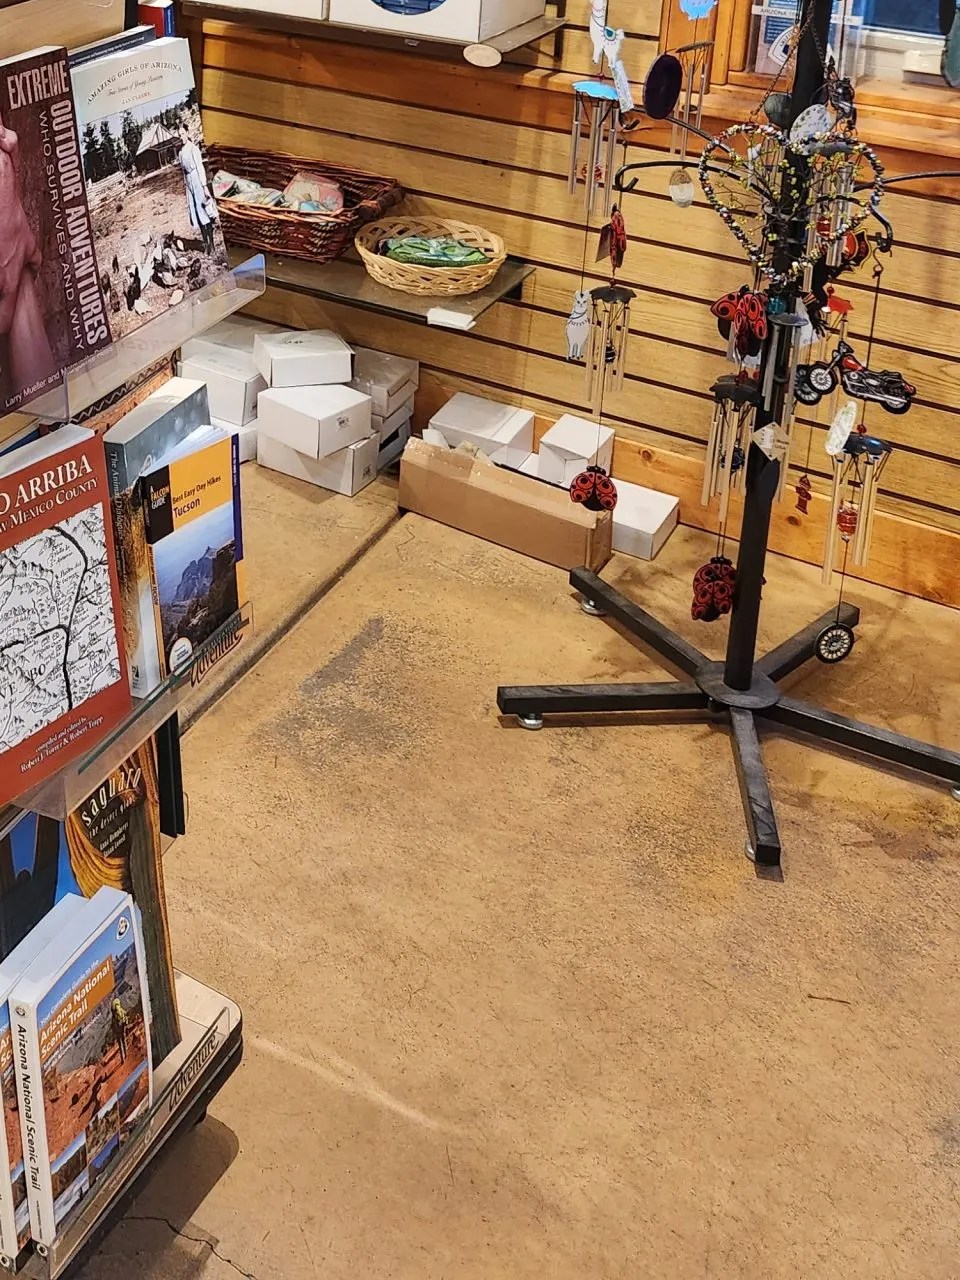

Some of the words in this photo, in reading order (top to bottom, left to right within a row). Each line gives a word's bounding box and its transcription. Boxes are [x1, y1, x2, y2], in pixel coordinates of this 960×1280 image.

[760, 7, 787, 17] ARIZONA
[6, 60, 70, 111] EXTREME
[86, 74, 117, 105] AMAZING
[117, 65, 139, 79] GIRLS
[140, 61, 149, 70] OF
[150, 61, 183, 73] ARIZONA
[50, 99, 84, 202] OUTDOOR
[39, 110, 52, 156] WHO
[46, 162, 68, 256] SURVIVES
[61, 261, 75, 301] AND
[69, 310, 86, 351] WHY
[65, 204, 108, 347] ADVENTURES
[5, 391, 23, 408] Larry
[23, 378, 47, 396] Mueller
[47, 371, 61, 384] and
[109, 451, 119, 467] The
[14, 454, 93, 508] ARRIBA
[111, 468, 123, 499] Animal
[150, 484, 170, 502] FALCON
[172, 494, 184, 505] Best
[183, 488, 196, 500] Easy
[196, 482, 207, 493] Day
[206, 475, 222, 487] Hikes
[113, 498, 126, 541] Dialogues
[151, 497, 166, 510] GUIDE
[173, 497, 201, 519] Tucson
[21, 755, 41, 773] Robert
[69, 726, 88, 741] Robert
[35, 734, 58, 753] compiled
[81, 767, 142, 827] saguaro
[89, 825, 99, 839] the
[100, 810, 118, 830] desert
[41, 1002, 73, 1044] Arizona
[73, 960, 110, 1006] National
[17, 1023, 29, 1070] Arizona
[41, 1022, 69, 1059] Scenic
[68, 998, 88, 1026] Trail
[22, 1073, 36, 1124] National
[26, 1124, 38, 1164] Scenic
[31, 1161, 42, 1191] Trail
